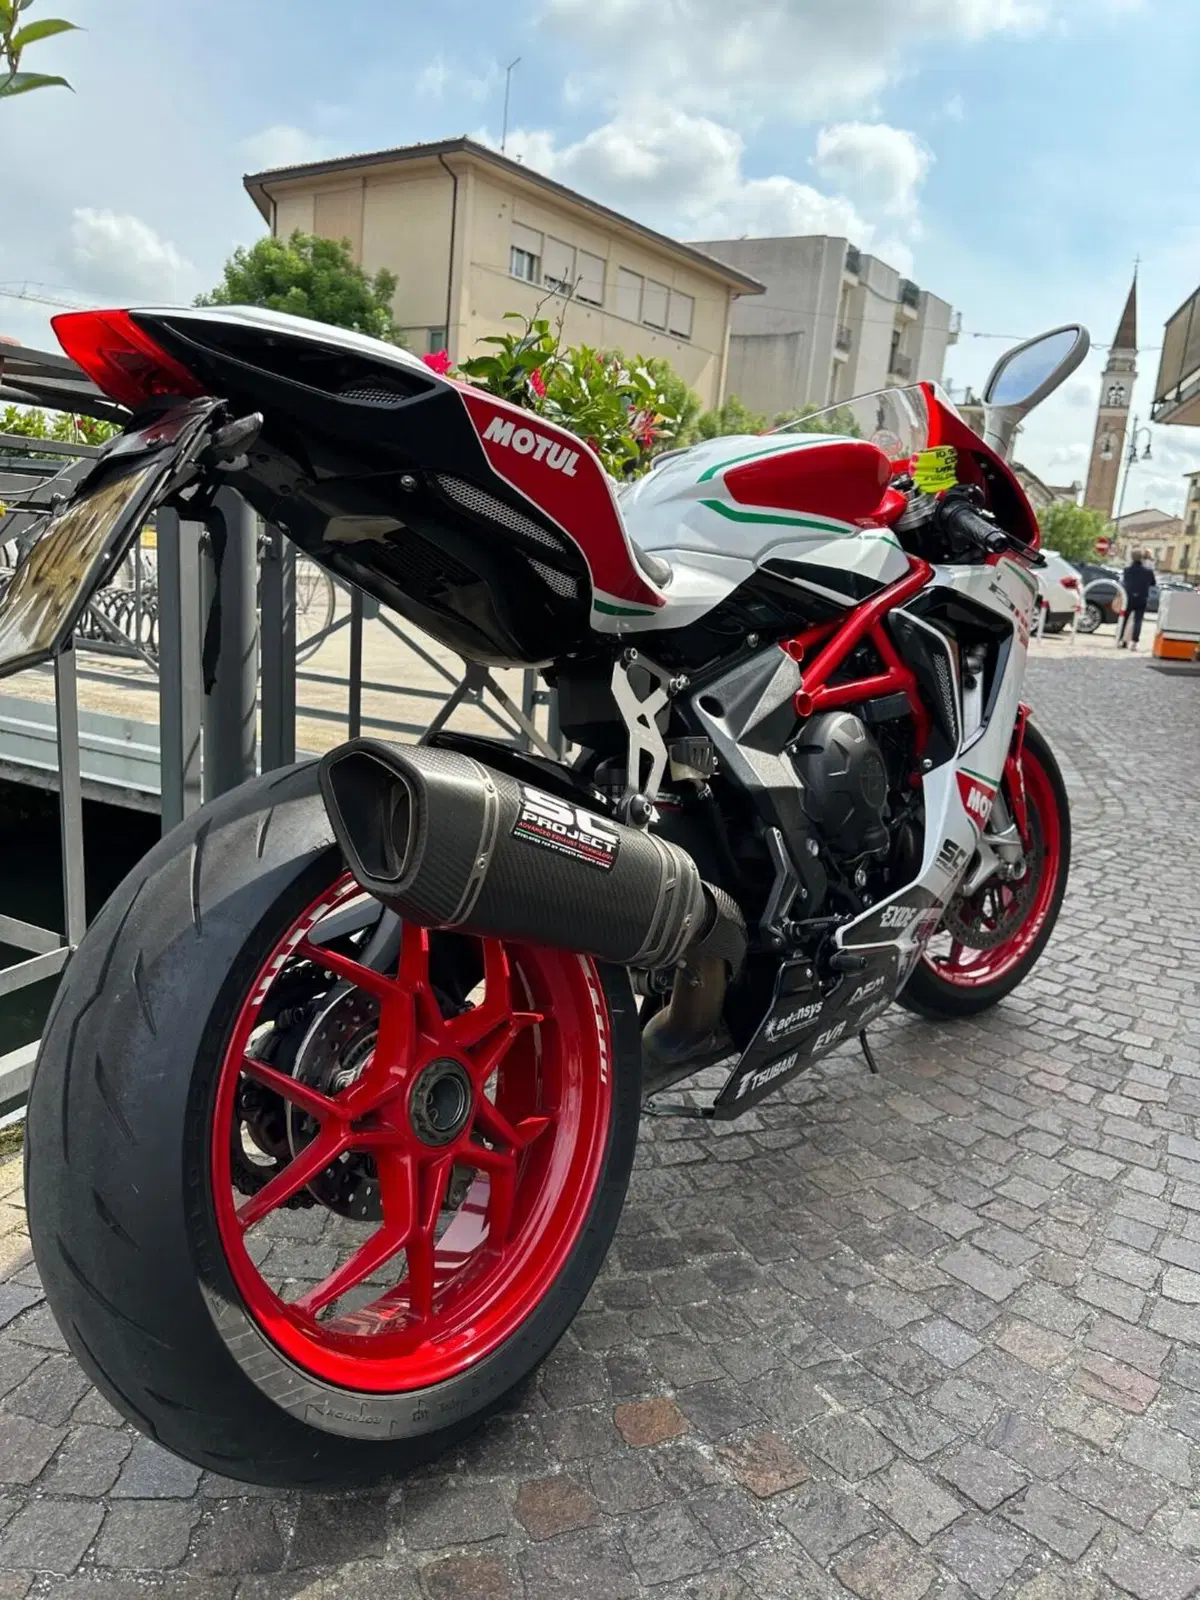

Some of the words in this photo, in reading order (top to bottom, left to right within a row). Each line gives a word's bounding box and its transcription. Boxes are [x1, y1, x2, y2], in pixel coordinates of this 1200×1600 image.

[482, 416, 580, 477] MOTUL
[518, 821, 551, 838] ADVANCED
[521, 811, 616, 853] PROJECT
[523, 786, 620, 845] SC
[751, 1052, 799, 1091] TSUBAKI
